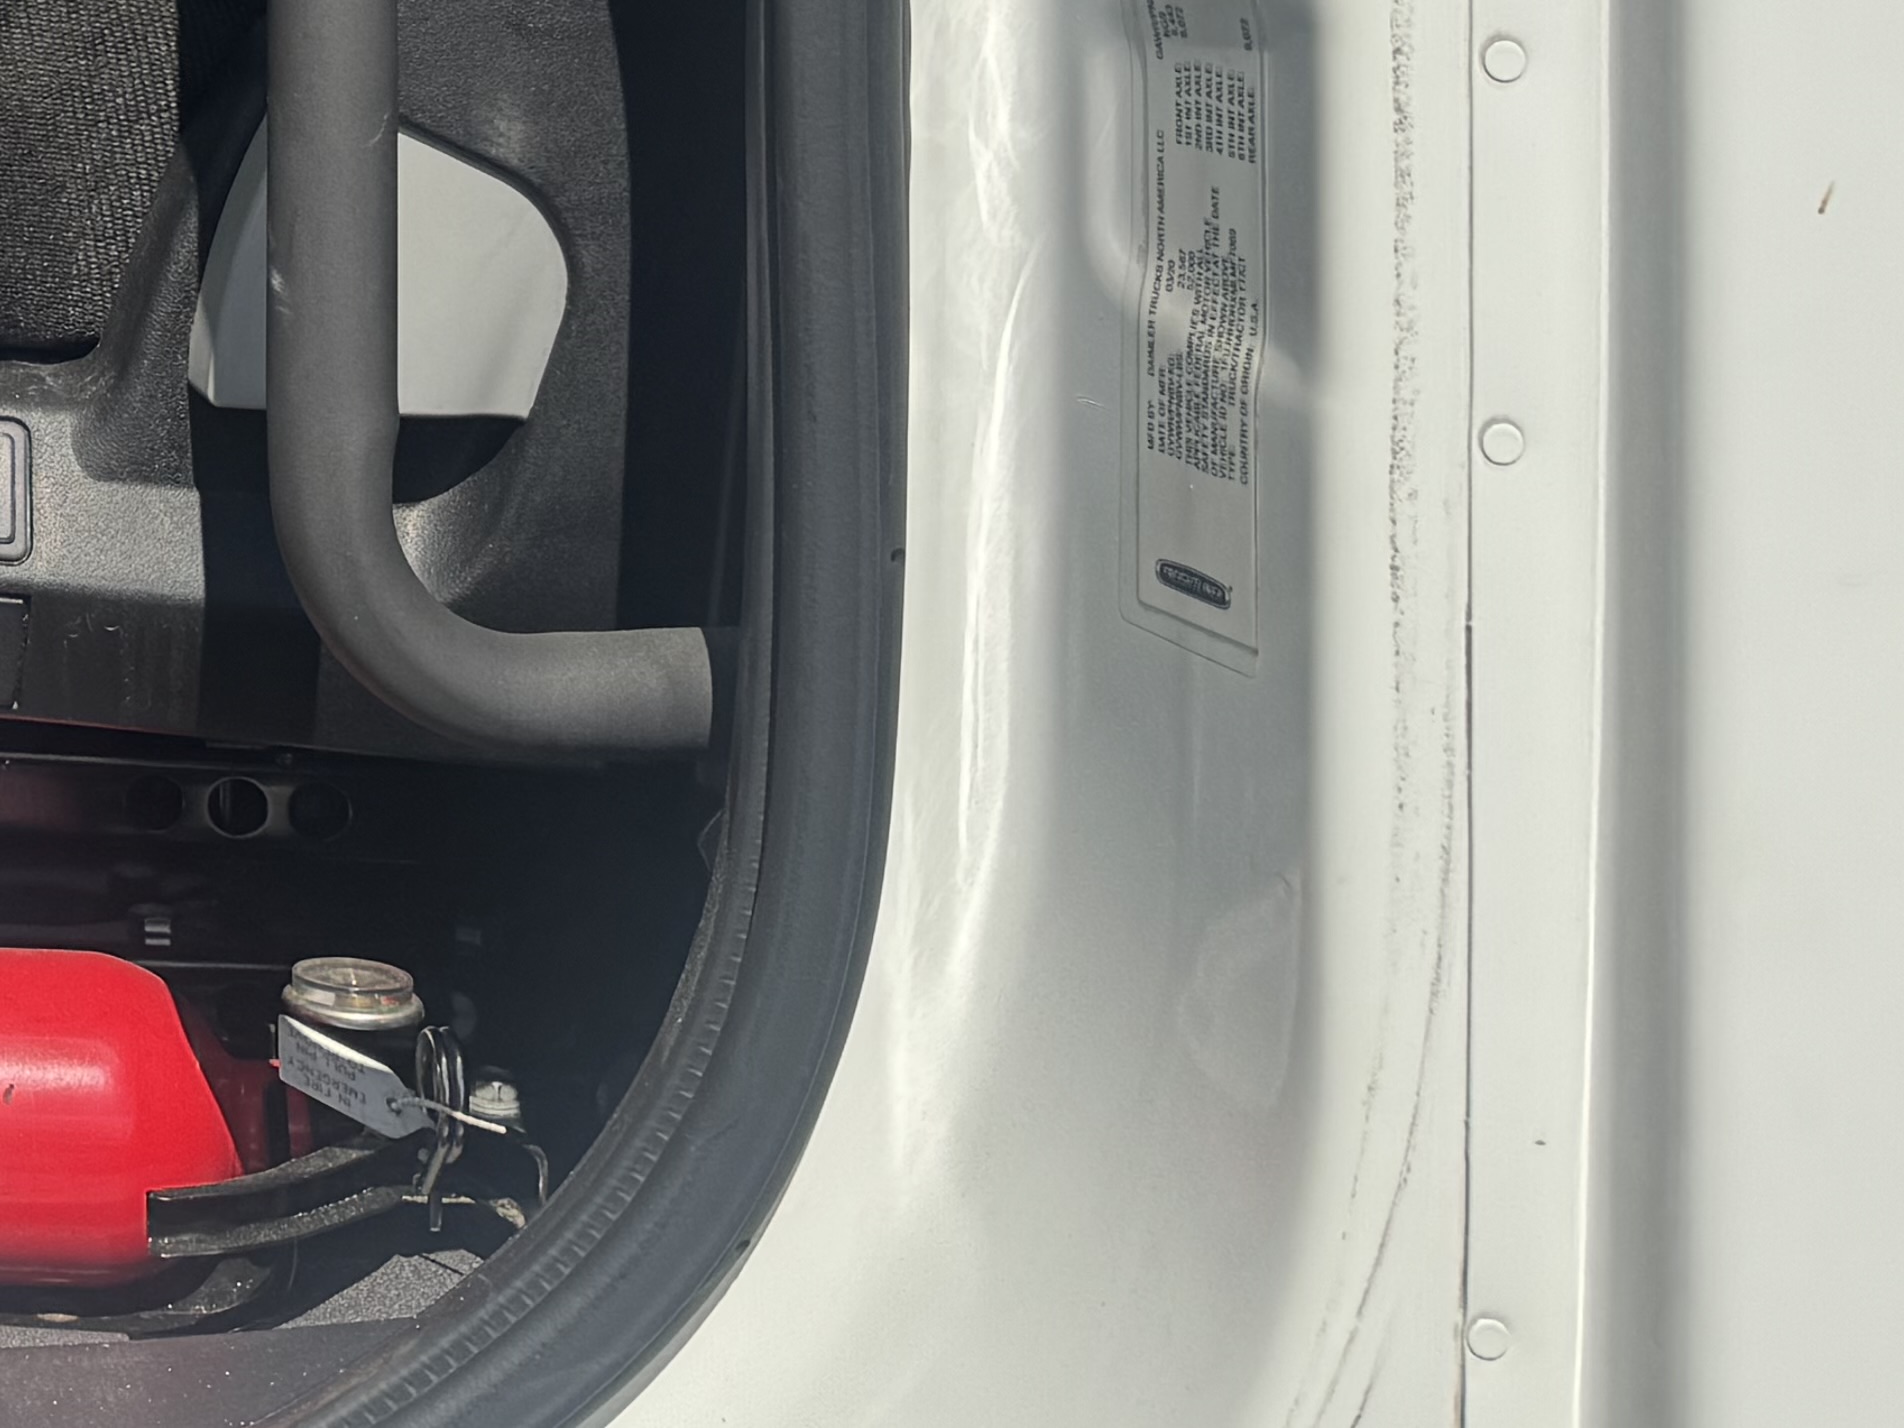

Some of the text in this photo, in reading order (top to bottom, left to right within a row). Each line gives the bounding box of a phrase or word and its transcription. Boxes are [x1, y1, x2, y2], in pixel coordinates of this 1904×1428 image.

[288, 1055, 367, 1103] EMERGENCY
[325, 1058, 357, 1081] PULL
[302, 1075, 351, 1109] IN FIRE
